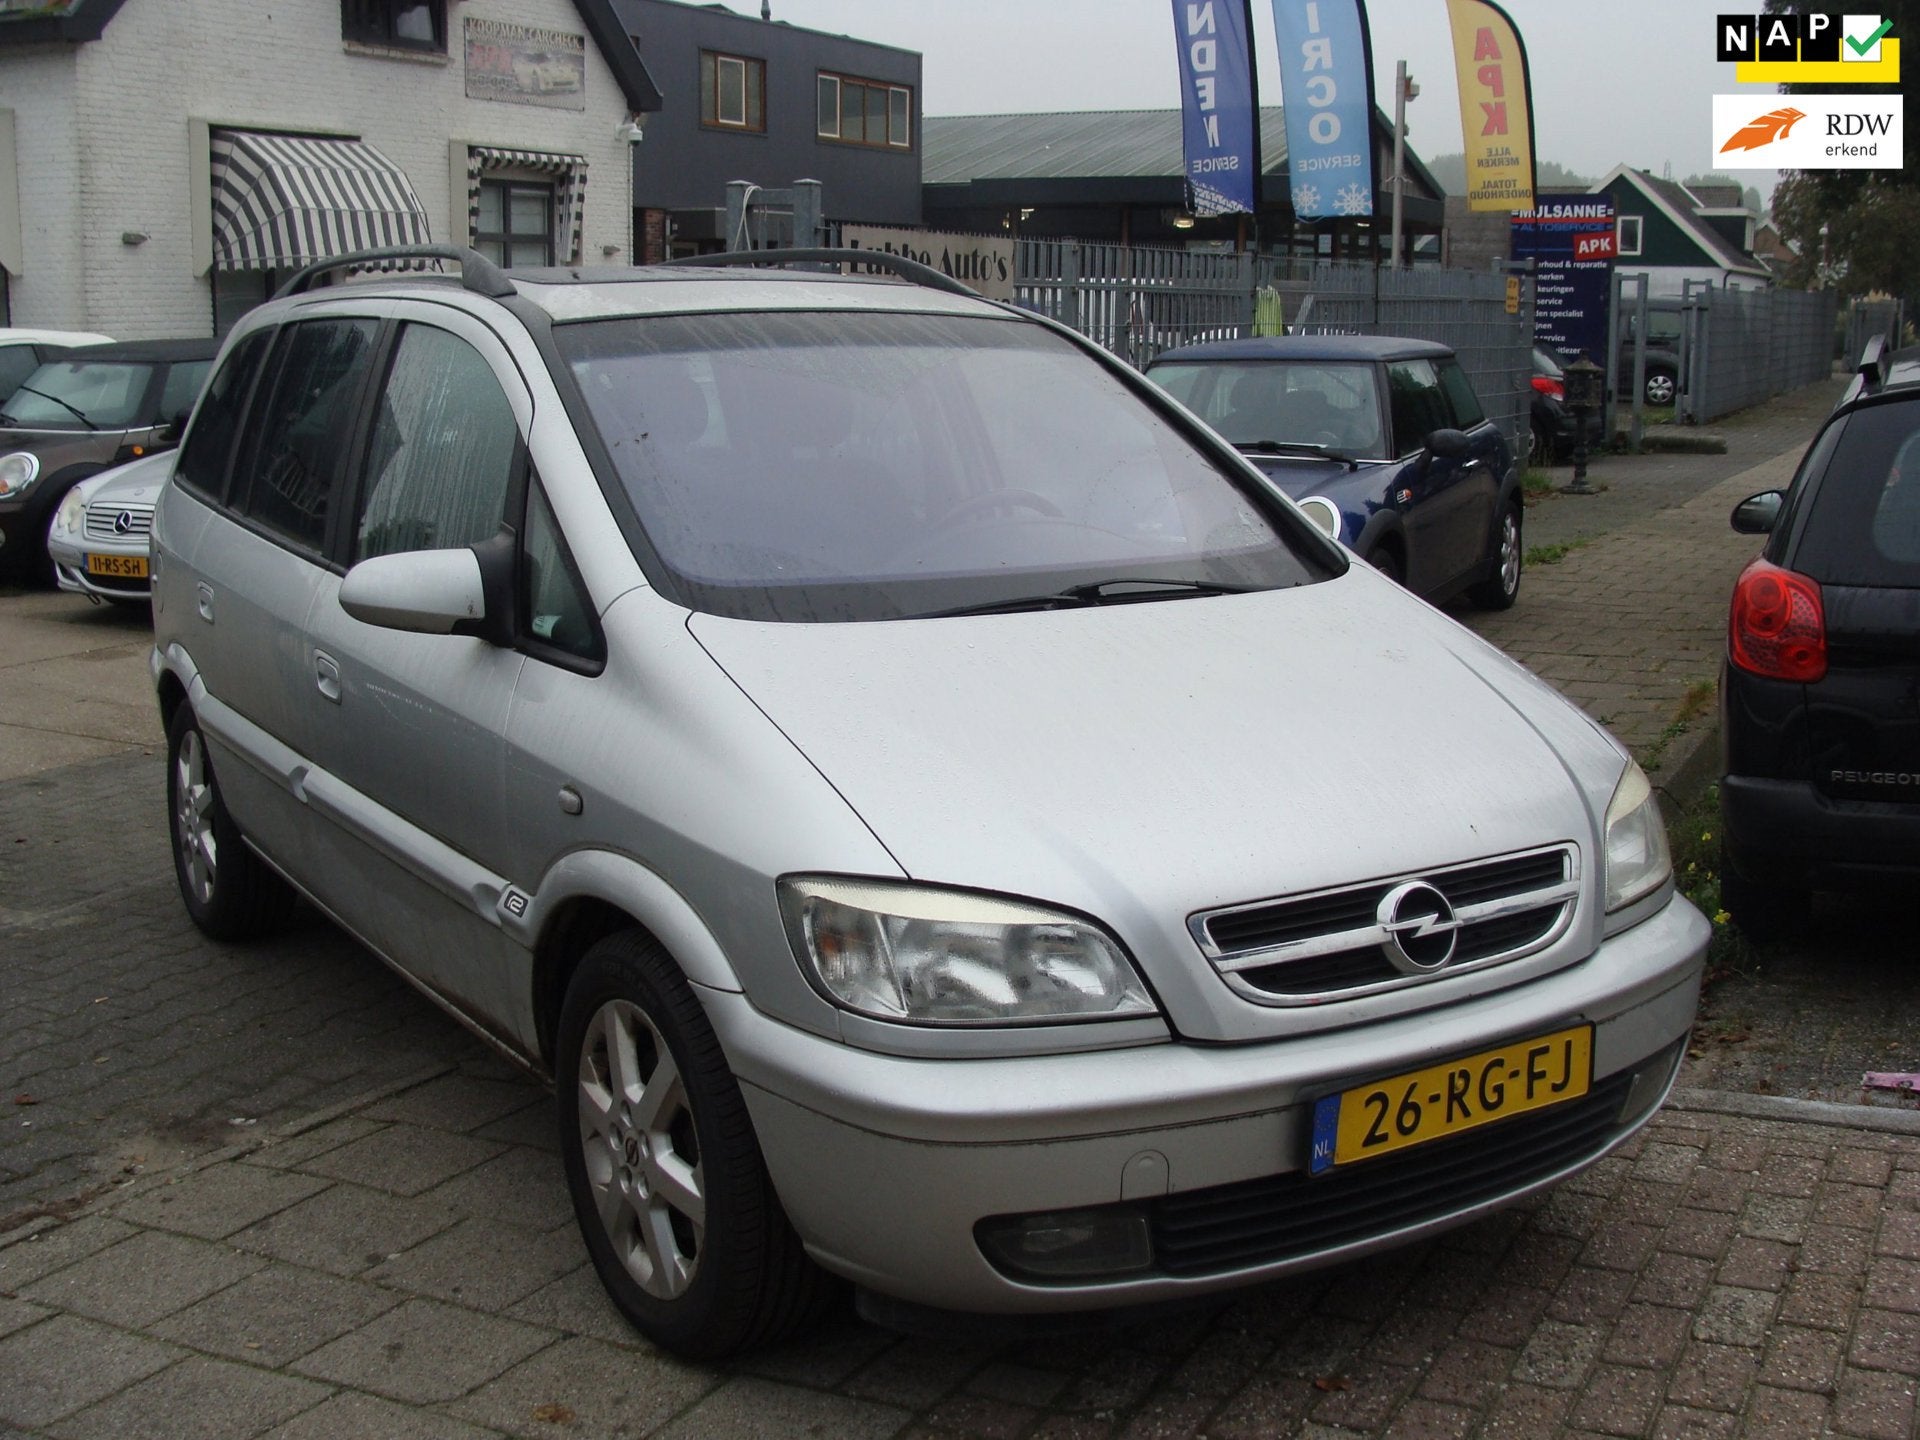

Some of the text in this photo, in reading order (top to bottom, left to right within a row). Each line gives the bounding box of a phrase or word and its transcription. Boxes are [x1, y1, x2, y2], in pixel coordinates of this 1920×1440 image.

[1578, 237, 1612, 254] APK
[938, 245, 1007, 282] Auto's
[1565, 260, 1572, 269] &
[1573, 260, 1608, 271] reparatie
[1549, 310, 1584, 319] specialist
[1831, 769, 1920, 785] PEUGEOT
[1361, 1039, 1573, 1148] 26-RG-FJ
[1314, 1140, 1331, 1160] NL
